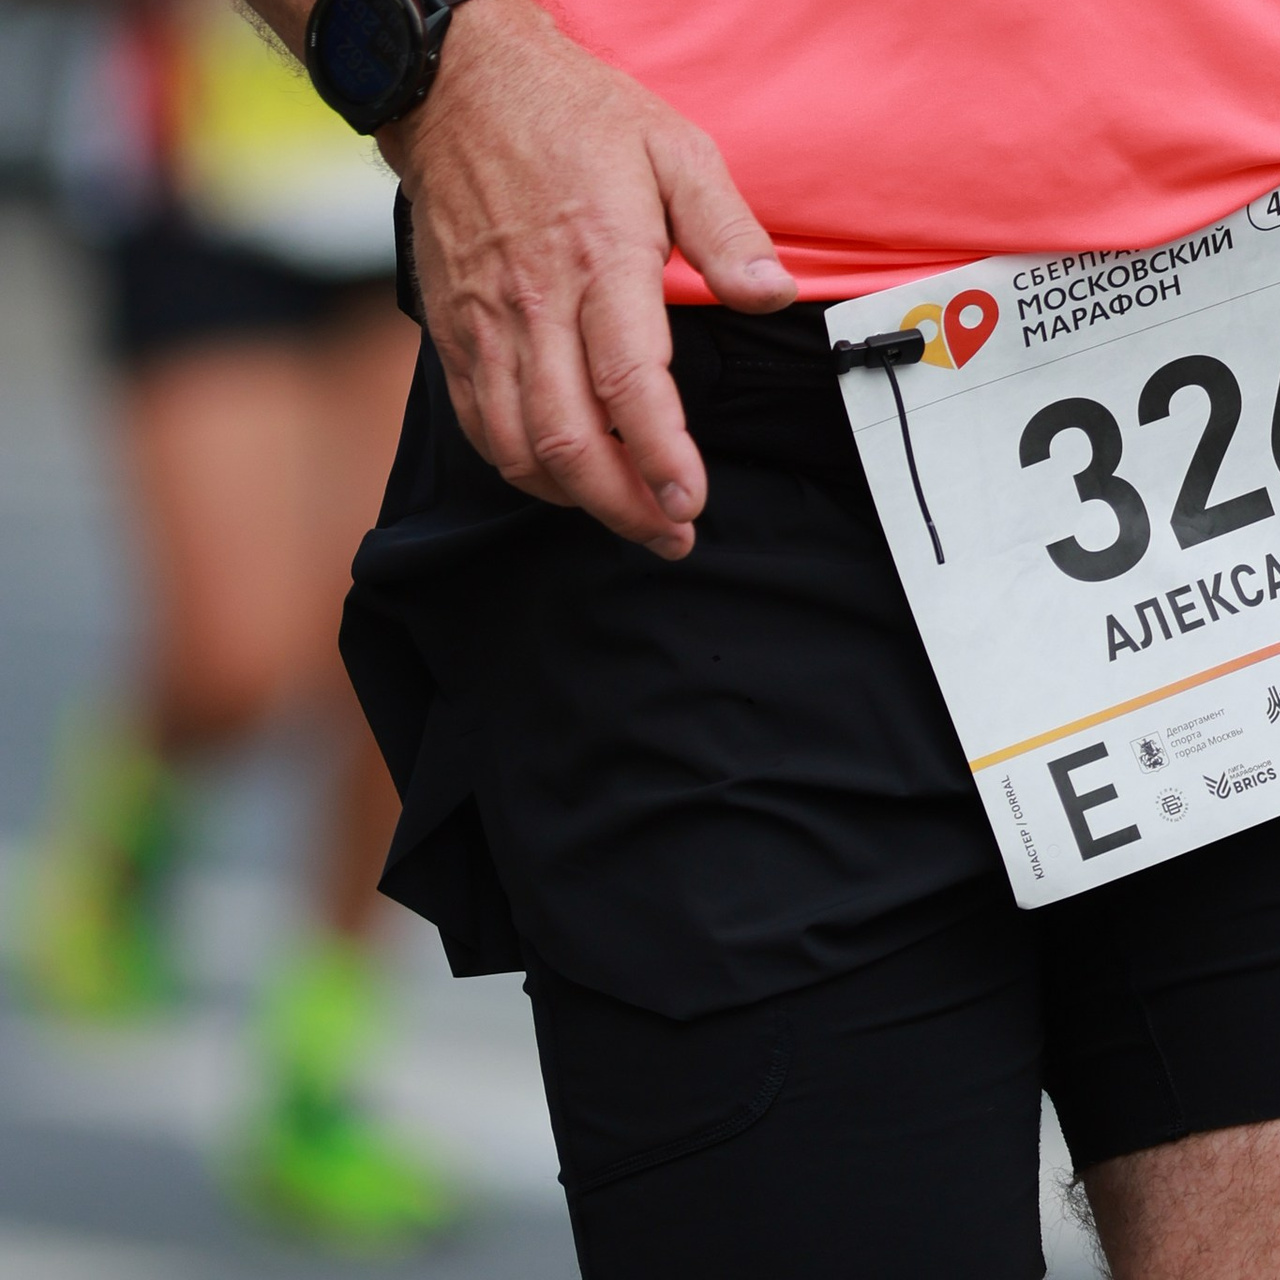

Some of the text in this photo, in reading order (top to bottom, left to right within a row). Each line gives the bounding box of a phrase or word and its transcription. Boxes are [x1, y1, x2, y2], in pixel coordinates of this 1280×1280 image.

[1017, 225, 1234, 321] МОСКОВСКИЙ
[1022, 274, 1182, 348] МАРАФОН
[1166, 708, 1226, 738] Департамент
[1170, 730, 1202, 748] спорта
[1174, 727, 1244, 759] города Москвы
[1001, 774, 1024, 820] CORRAL
[1232, 767, 1277, 794] BRICS
[1020, 829, 1045, 880] КЛАСТЕР
